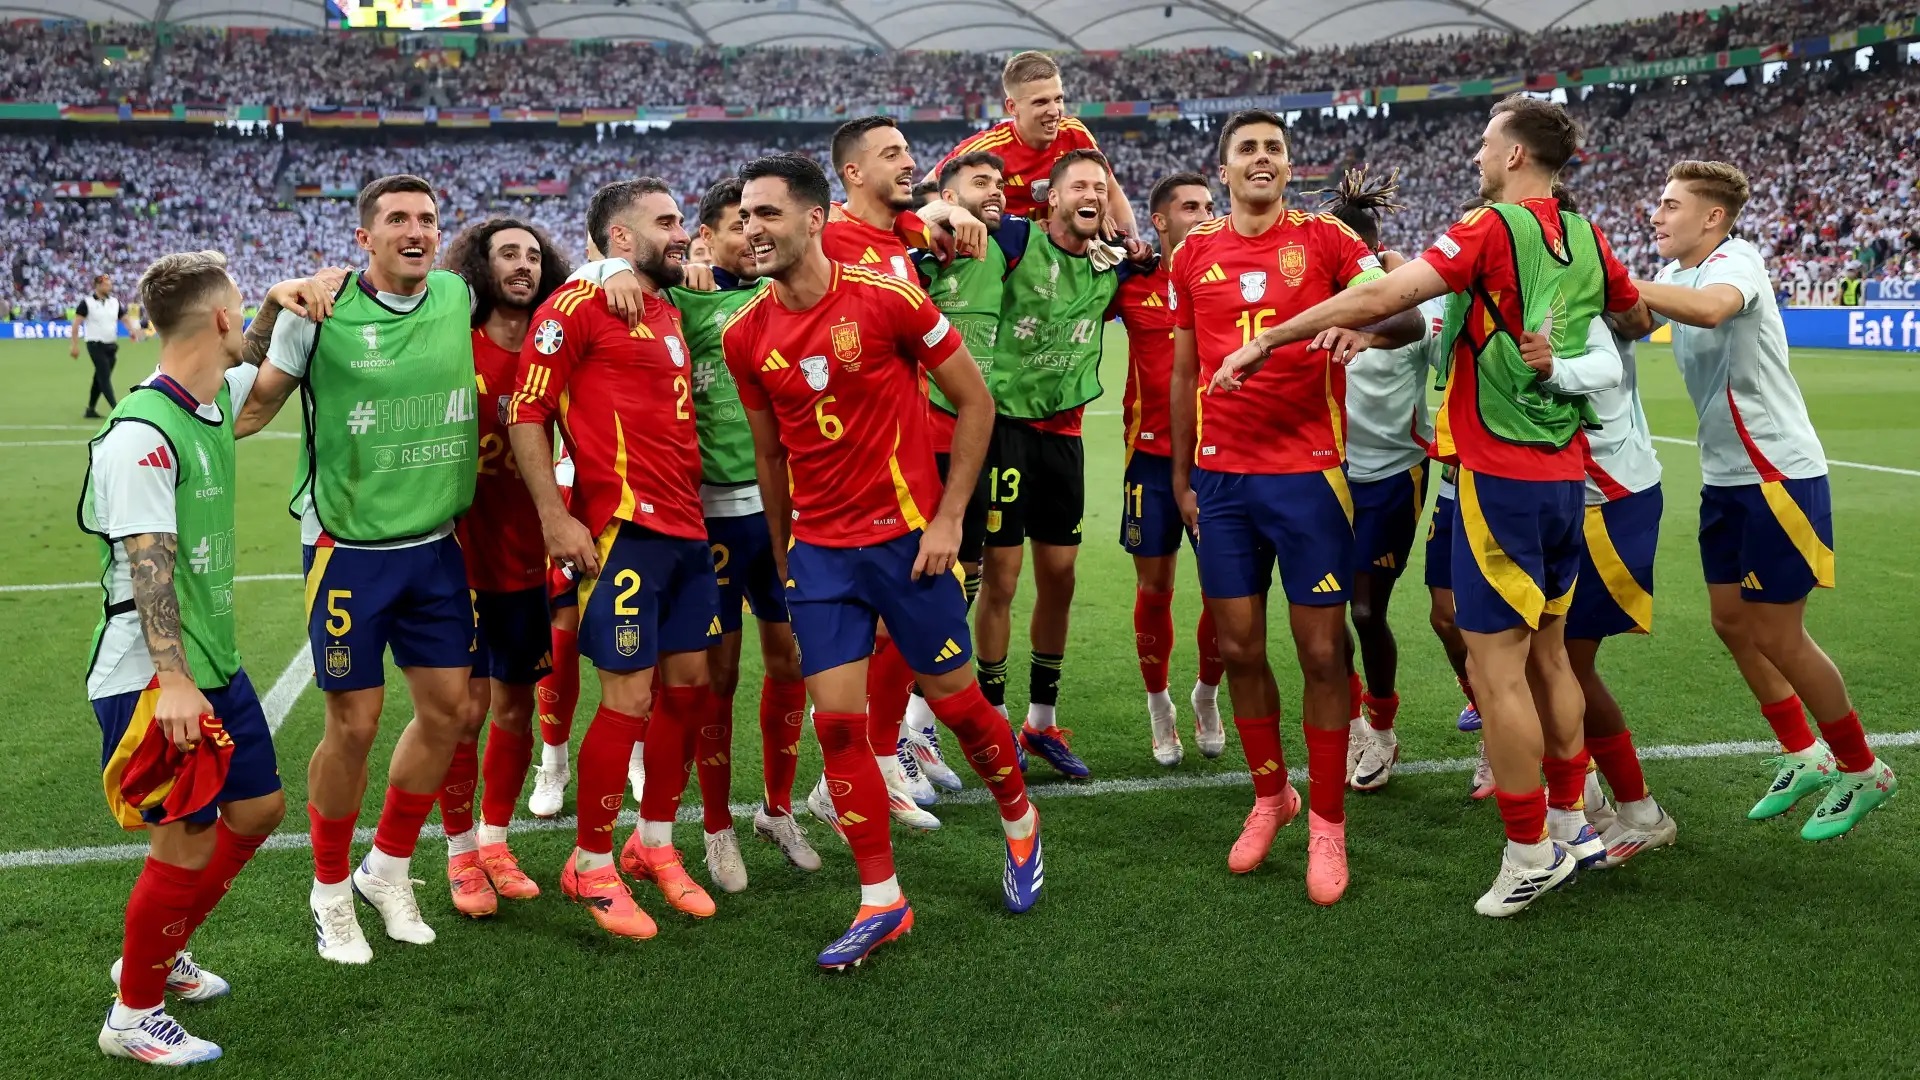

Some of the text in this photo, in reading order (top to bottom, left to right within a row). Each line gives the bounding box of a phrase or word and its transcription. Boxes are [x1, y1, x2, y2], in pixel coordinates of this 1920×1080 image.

[1610, 57, 1707, 80] STUTTGART
[1879, 280, 1916, 299] KSC
[13, 322, 44, 338] Eat
[1848, 311, 1894, 346] Eat
[350, 358, 396, 368] EURO2024
[346, 386, 475, 435] #FOOTBALL
[673, 374, 690, 420] 2
[814, 395, 844, 441] 6
[401, 439, 468, 464] RESPECT
[988, 467, 1021, 503] 13
[1125, 481, 1143, 518] 11
[614, 568, 640, 616] 2
[325, 590, 352, 637] 5
